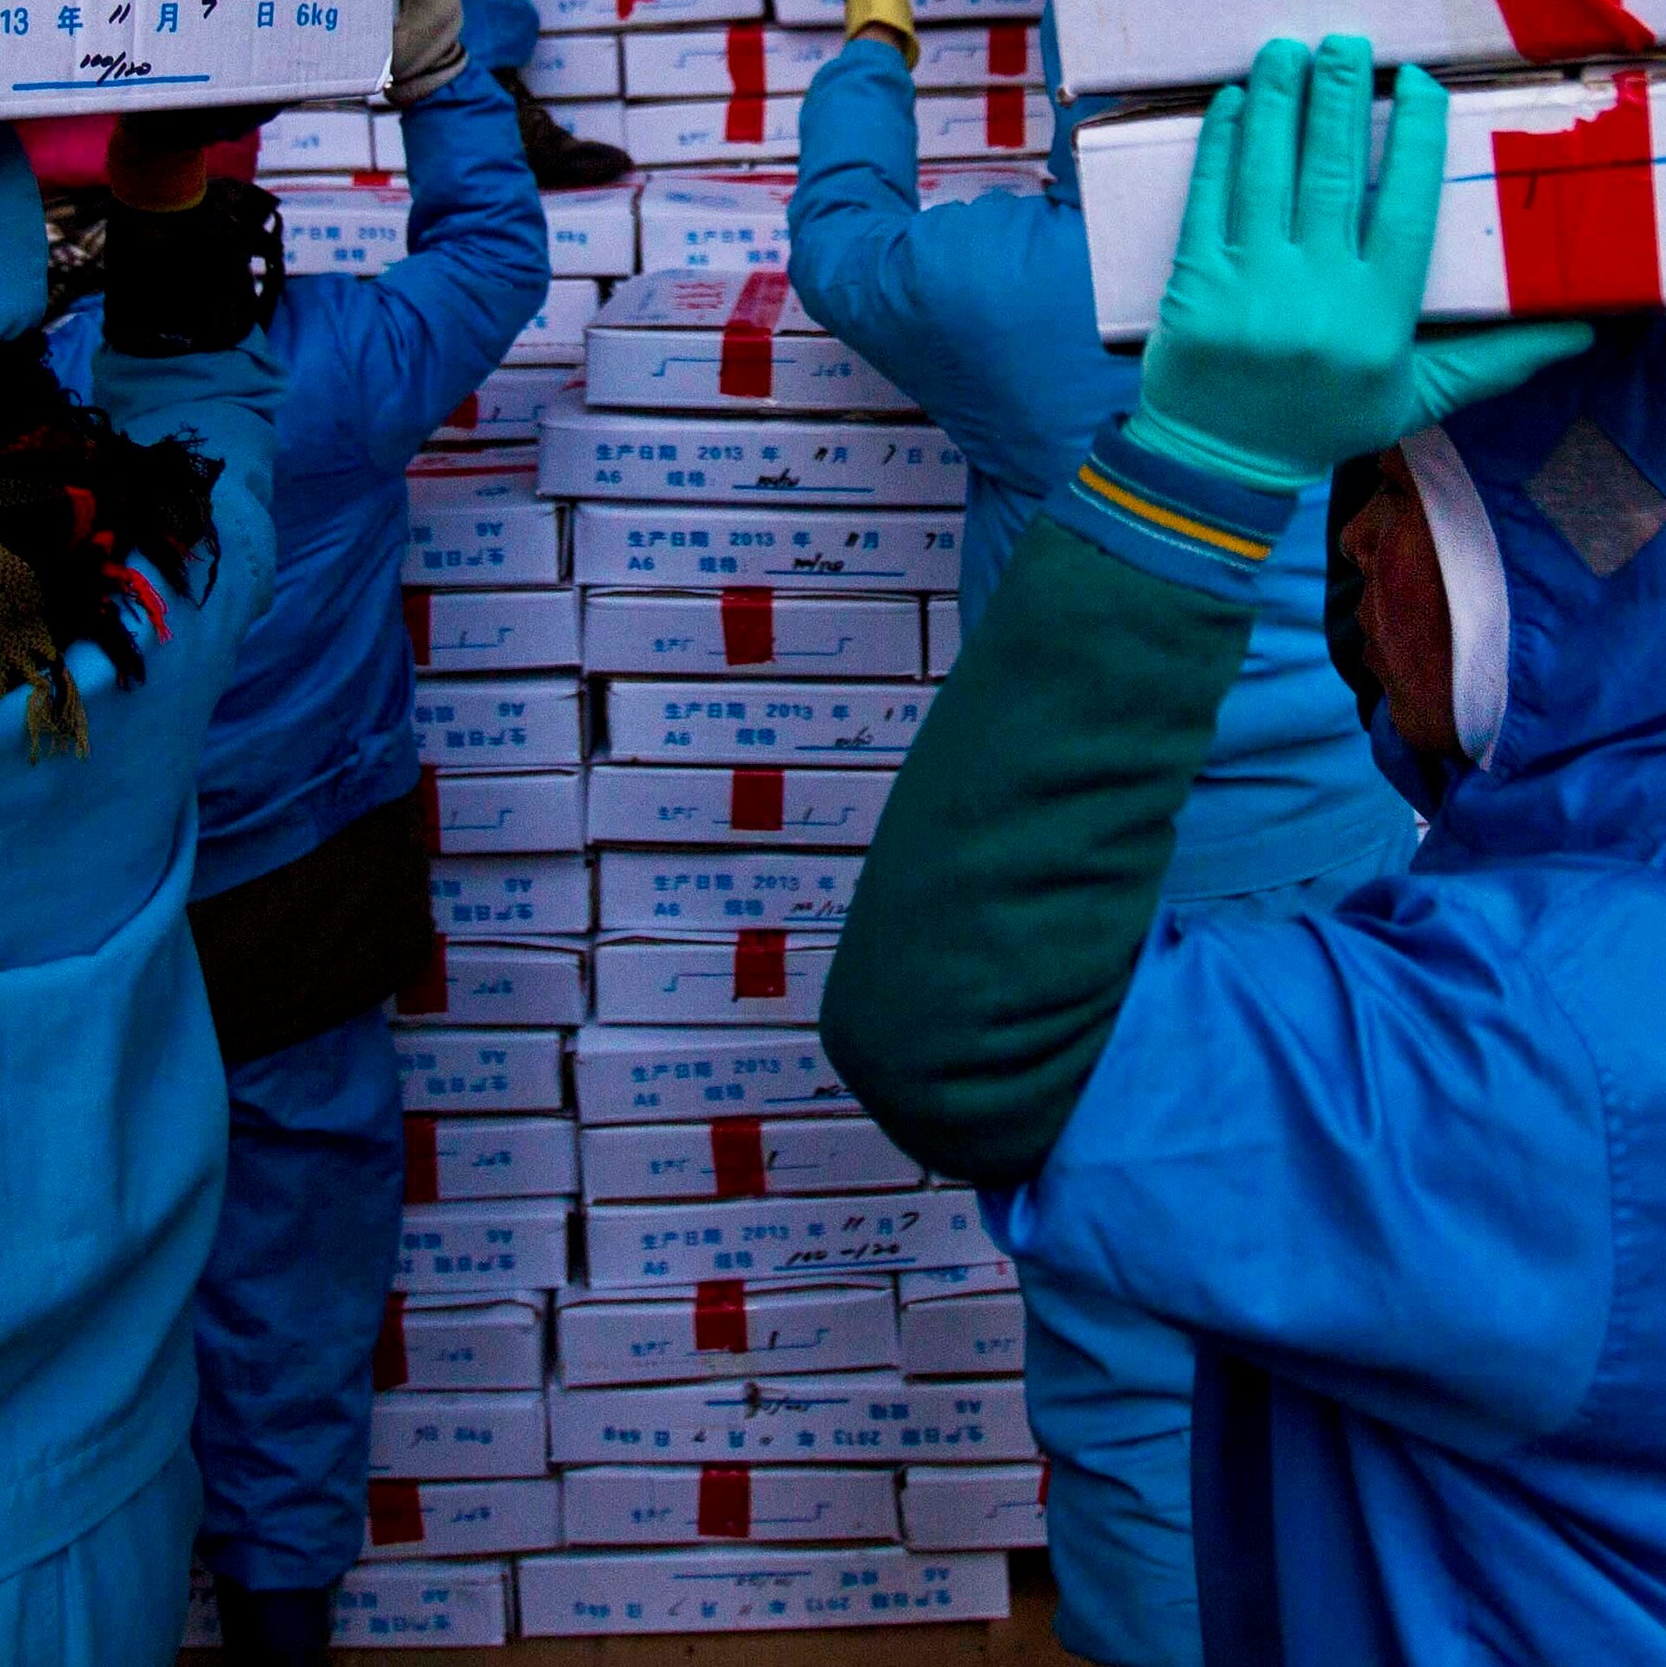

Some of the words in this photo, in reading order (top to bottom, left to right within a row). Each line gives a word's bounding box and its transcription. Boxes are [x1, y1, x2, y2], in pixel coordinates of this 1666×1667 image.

[56, 5, 83, 37] 年
[156, 2, 179, 33] 月
[256, 1, 275, 28] 日
[296, 2, 339, 32] 6kg
[595, 443, 678, 462] 生产日期
[698, 445, 743, 461] 2013
[627, 530, 710, 548] 生产日期
[729, 531, 776, 547] 2013
